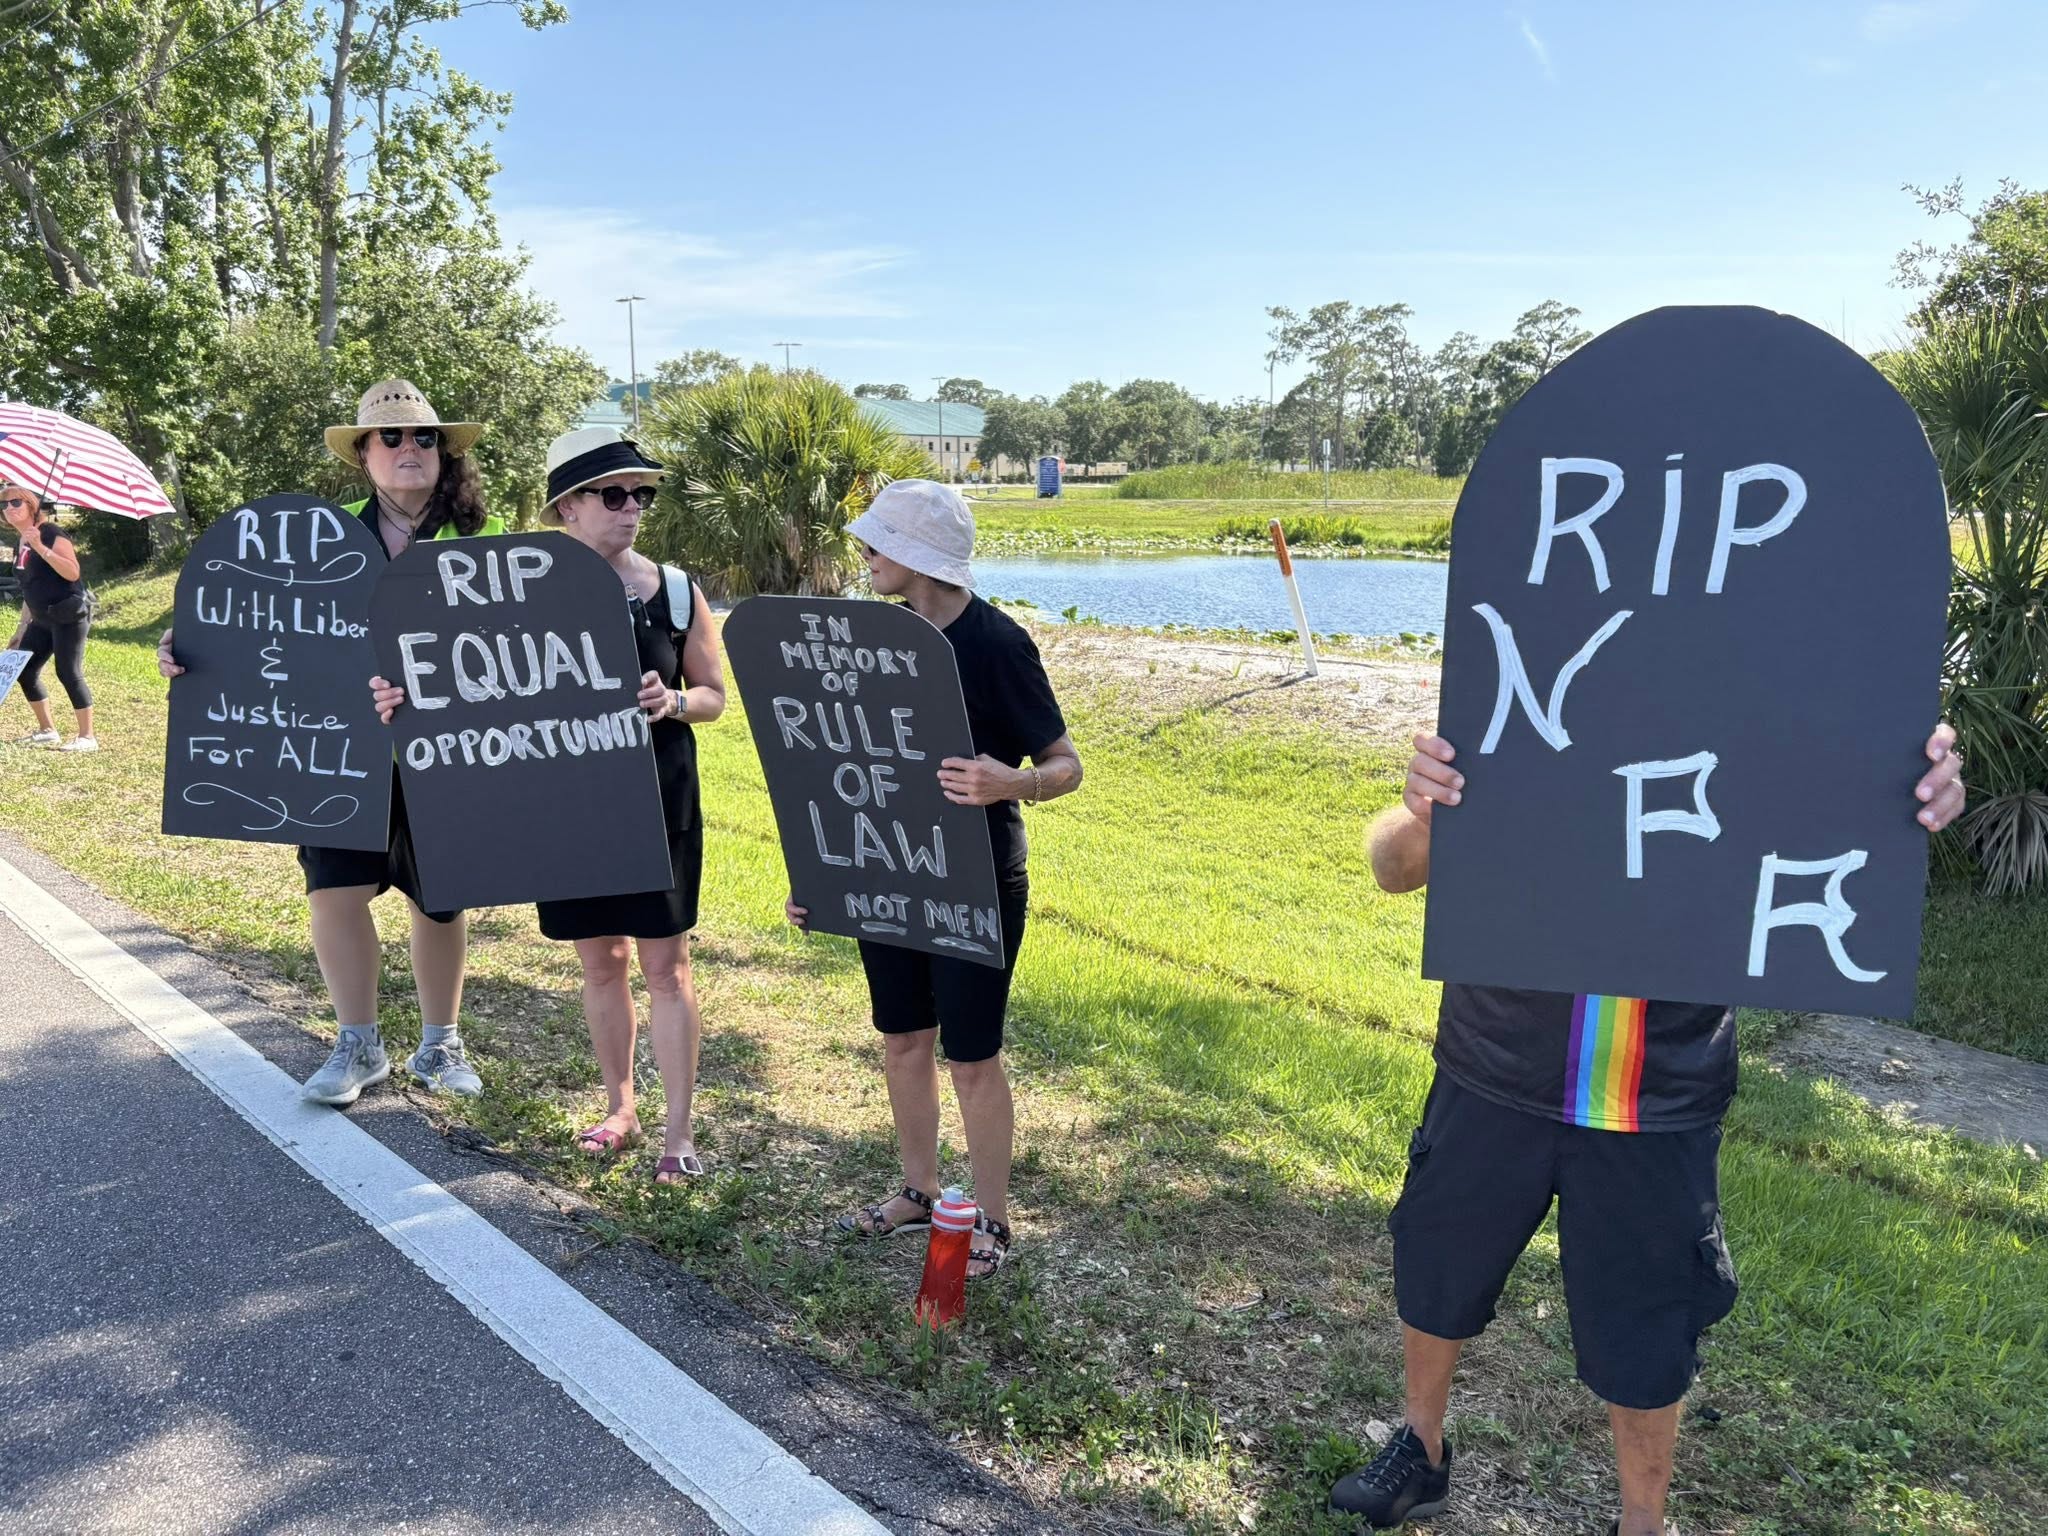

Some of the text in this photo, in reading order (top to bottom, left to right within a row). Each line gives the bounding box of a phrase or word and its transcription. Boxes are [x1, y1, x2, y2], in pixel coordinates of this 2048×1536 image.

[233, 507, 345, 563] RIP
[437, 546, 554, 606] RIP
[197, 586, 368, 638] With Liber
[800, 614, 852, 643] IN
[260, 638, 288, 688] &
[397, 632, 622, 710] EQUAL
[780, 641, 917, 676] MEMORY
[822, 672, 858, 696] OF
[208, 693, 348, 730] Justice
[773, 697, 925, 760] RULE
[189, 736, 367, 778] For ALL
[406, 707, 649, 771] OPPORTUNITY
[834, 763, 899, 807] OF
[809, 801, 947, 877] LAW
[846, 894, 997, 941] NOT MEN
